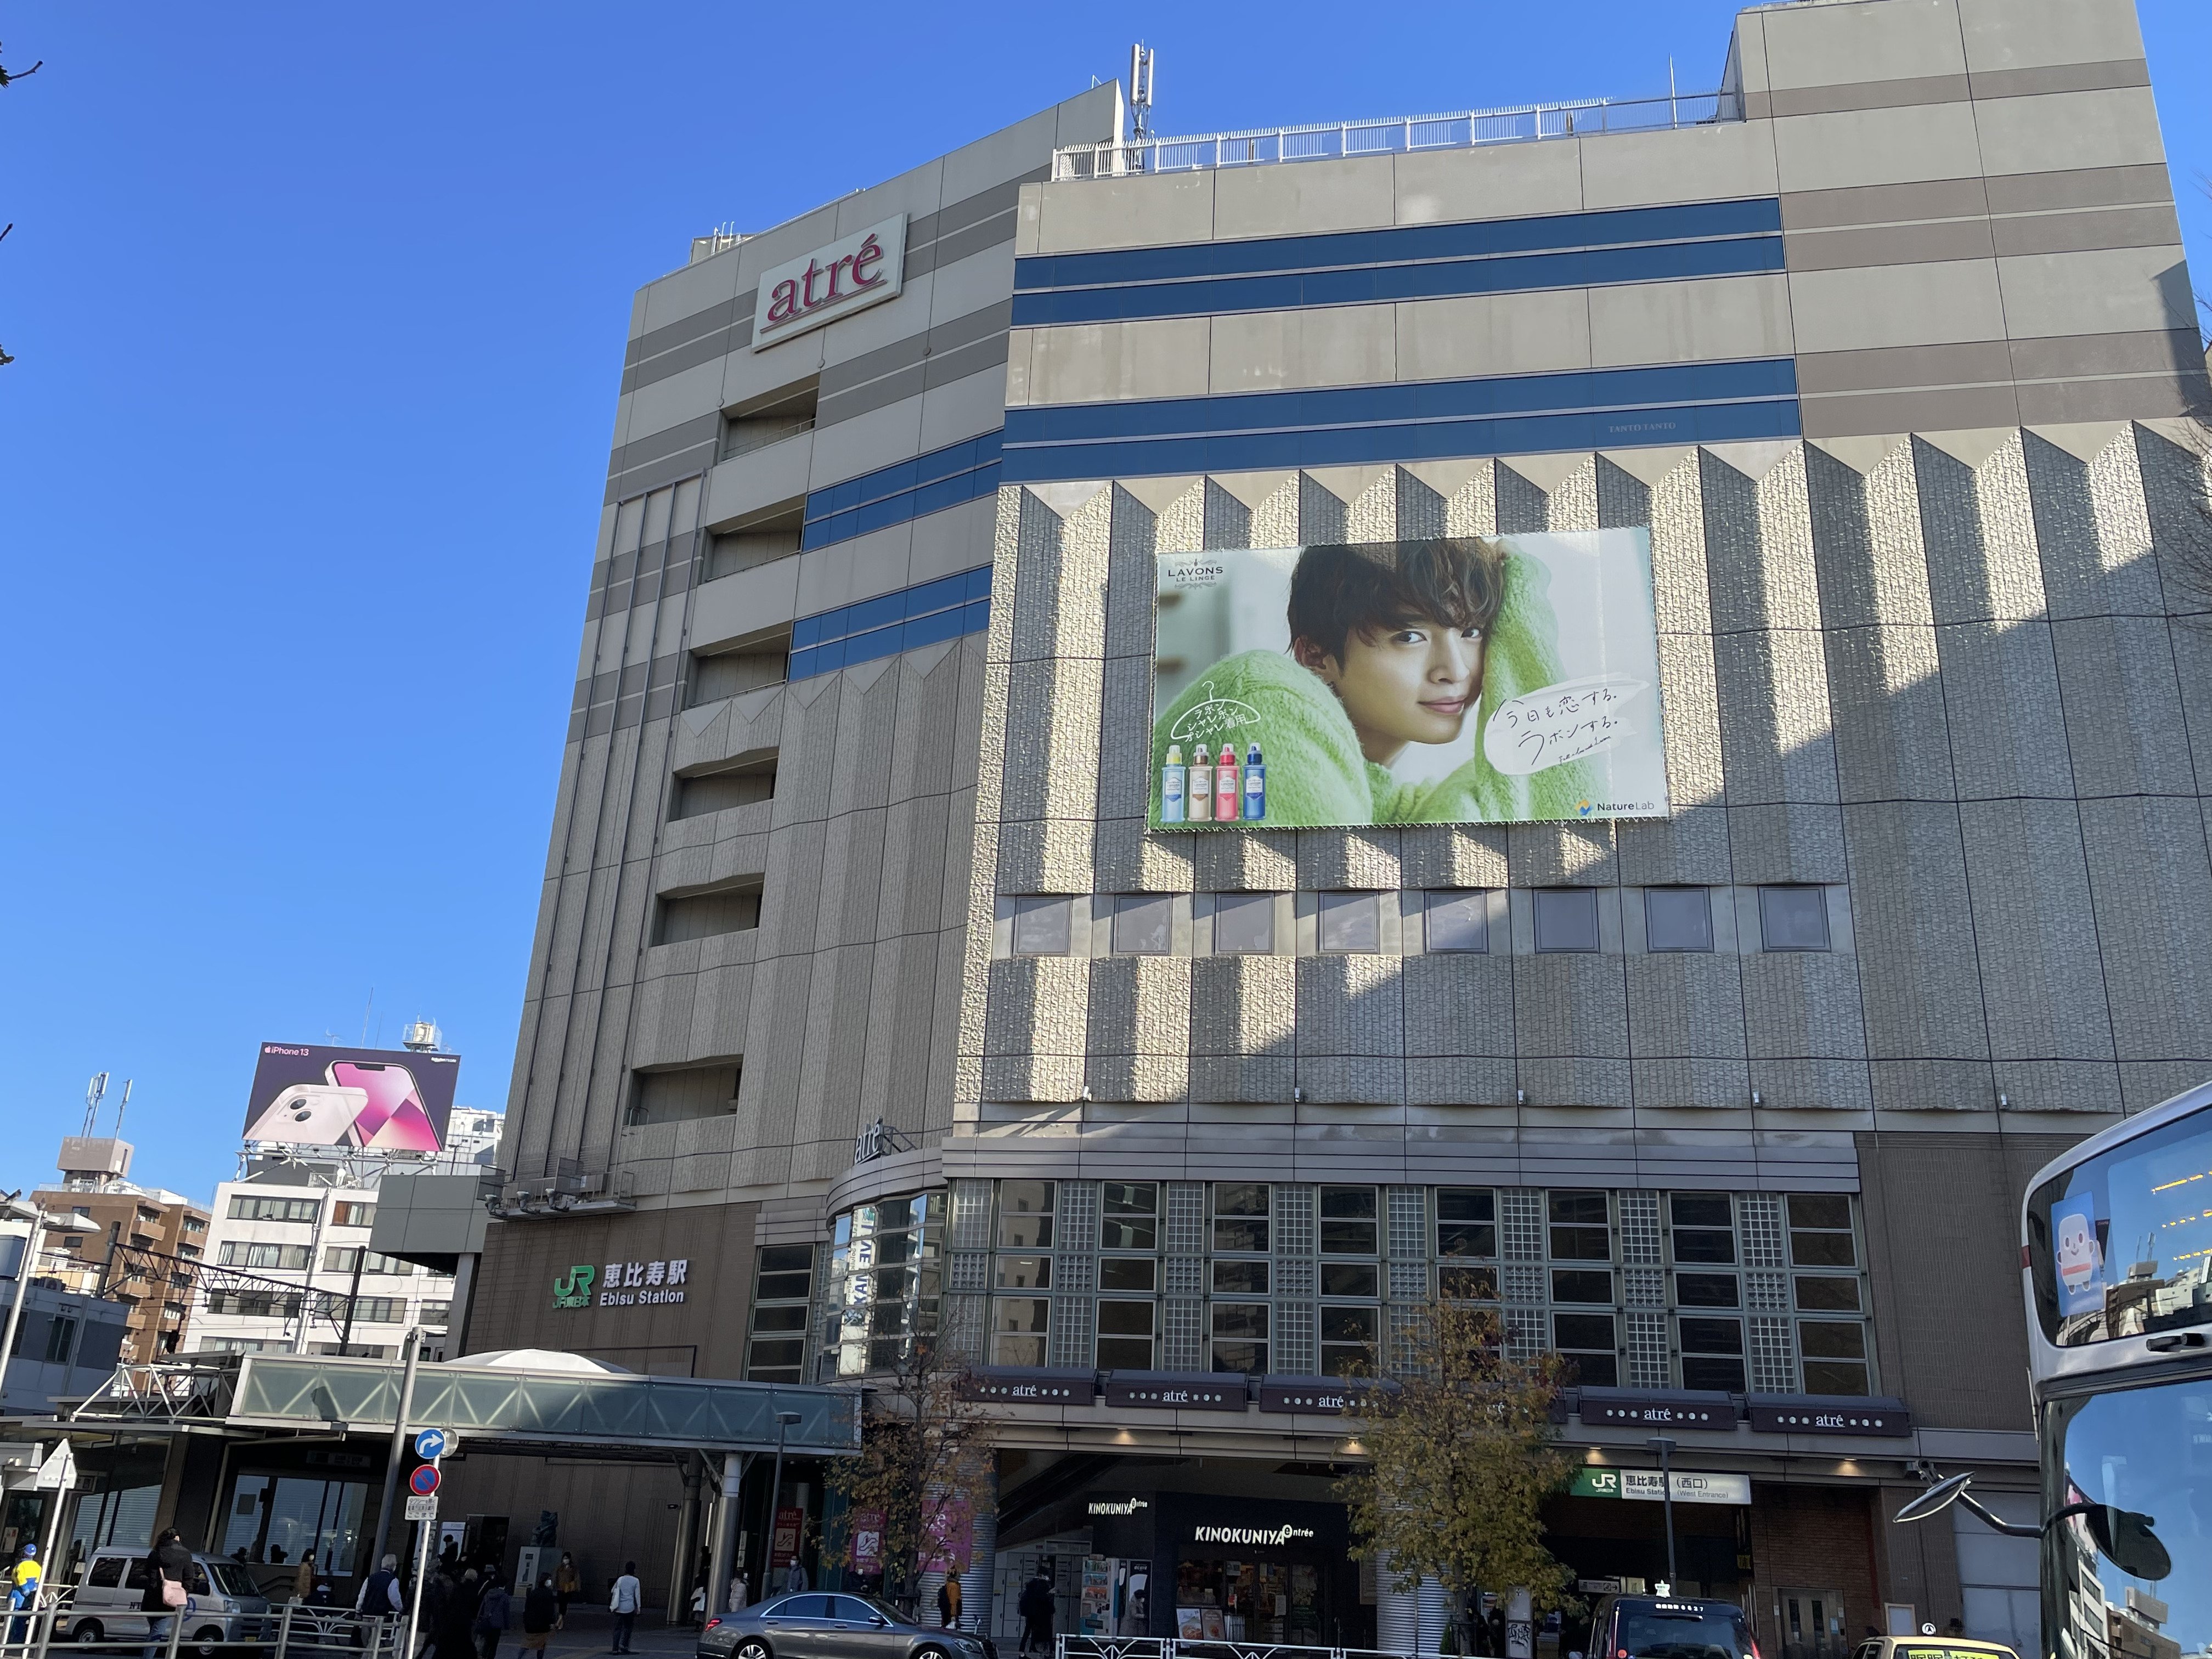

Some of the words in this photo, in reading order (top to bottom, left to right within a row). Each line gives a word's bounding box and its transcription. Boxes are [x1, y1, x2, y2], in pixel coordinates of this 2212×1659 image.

[768, 233, 884, 321] atré
[1609, 424, 1641, 433] TANTO
[1644, 422, 1676, 431] TANTO
[1168, 567, 1223, 577] LAVONS
[1597, 801, 1655, 811] NatureLab
[272, 1046, 299, 1056] iPhone
[300, 1048, 309, 1056] 13
[855, 1115, 883, 1163] atré
[602, 1260, 687, 1288] 恵比寿駅
[554, 1265, 595, 1296] JR
[600, 1291, 634, 1306] Ebisu
[639, 1289, 684, 1304] Station
[1012, 1385, 1037, 1396] atré
[1163, 1390, 1188, 1402] atré
[1319, 1396, 1344, 1407] atré
[1644, 1408, 1671, 1420] atré
[1816, 1414, 1844, 1426] atré
[1592, 1474, 1617, 1488] JR
[1088, 1503, 1132, 1515] KINOKUNIYA
[1195, 1526, 1284, 1545] KINOKUNIYA
[1282, 1524, 1314, 1538] entrée
